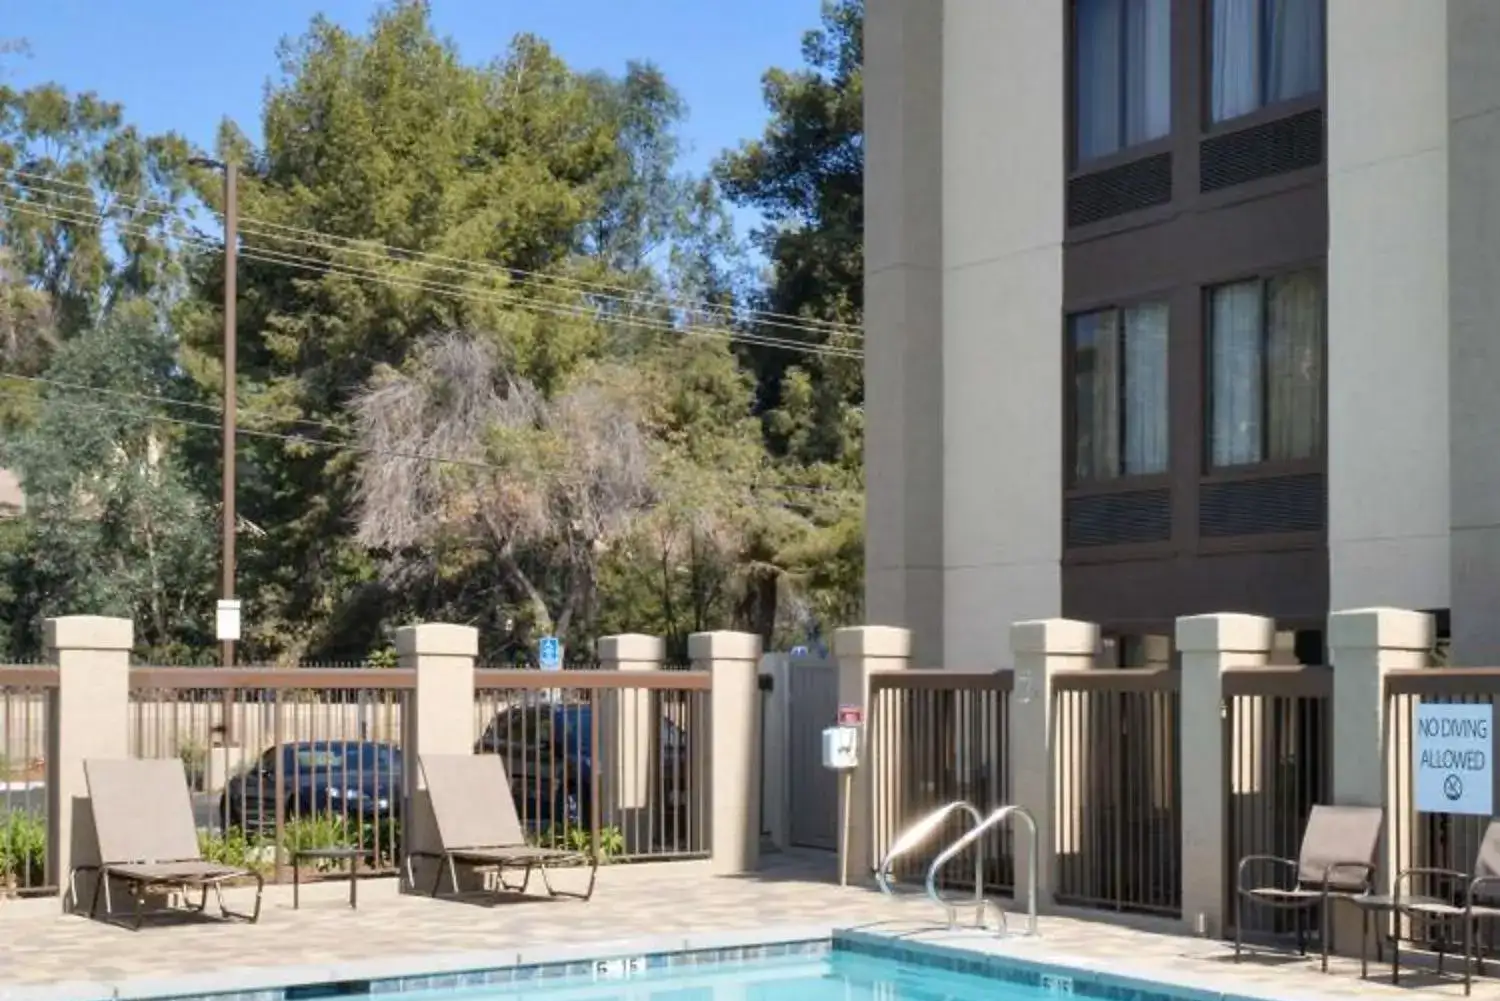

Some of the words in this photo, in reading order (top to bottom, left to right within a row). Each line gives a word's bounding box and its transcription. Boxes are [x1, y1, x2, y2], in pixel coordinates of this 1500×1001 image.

[1419, 717, 1439, 737] NO
[1441, 718, 1488, 739] DIVING
[1421, 749, 1486, 771] ALLOWED
